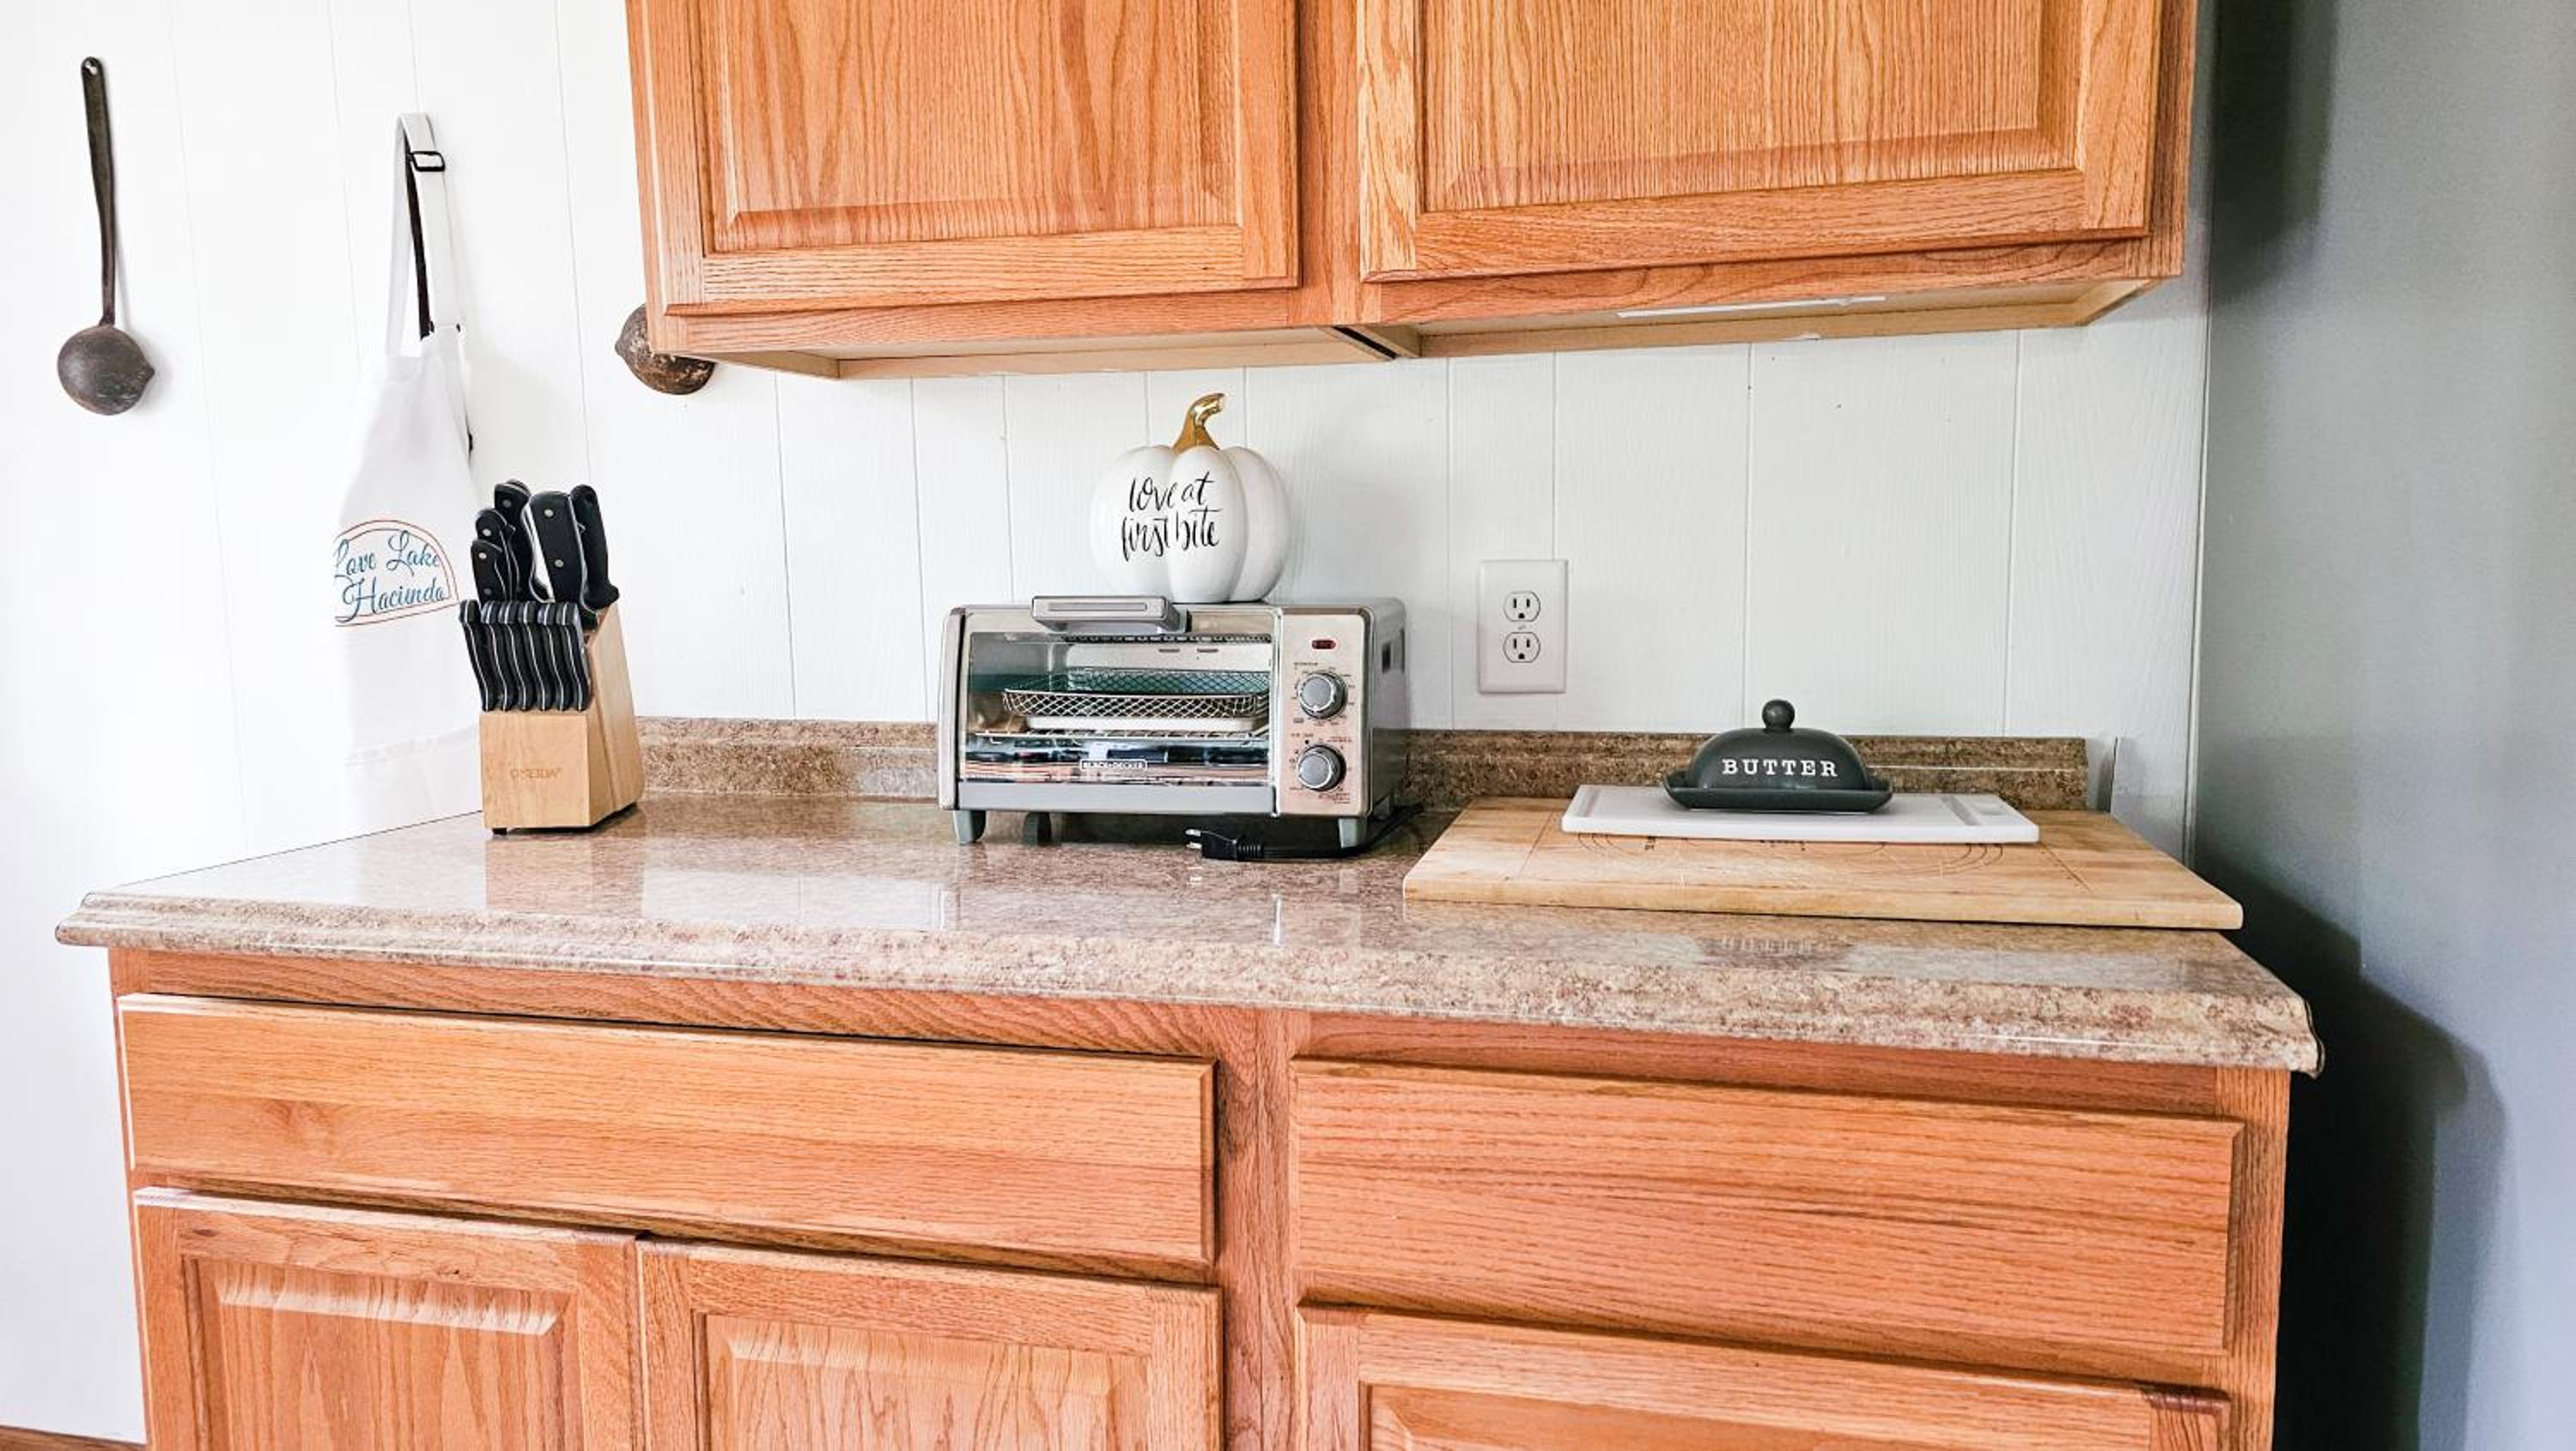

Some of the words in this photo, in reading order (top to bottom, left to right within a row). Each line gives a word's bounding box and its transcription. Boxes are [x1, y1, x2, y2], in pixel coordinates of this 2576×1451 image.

[1128, 477, 1178, 513] love
[1181, 471, 1215, 506] at
[386, 530, 440, 577] Lake
[1121, 516, 1170, 562] first
[1174, 506, 1223, 550] bite
[1722, 758, 1838, 778] BUTTER
